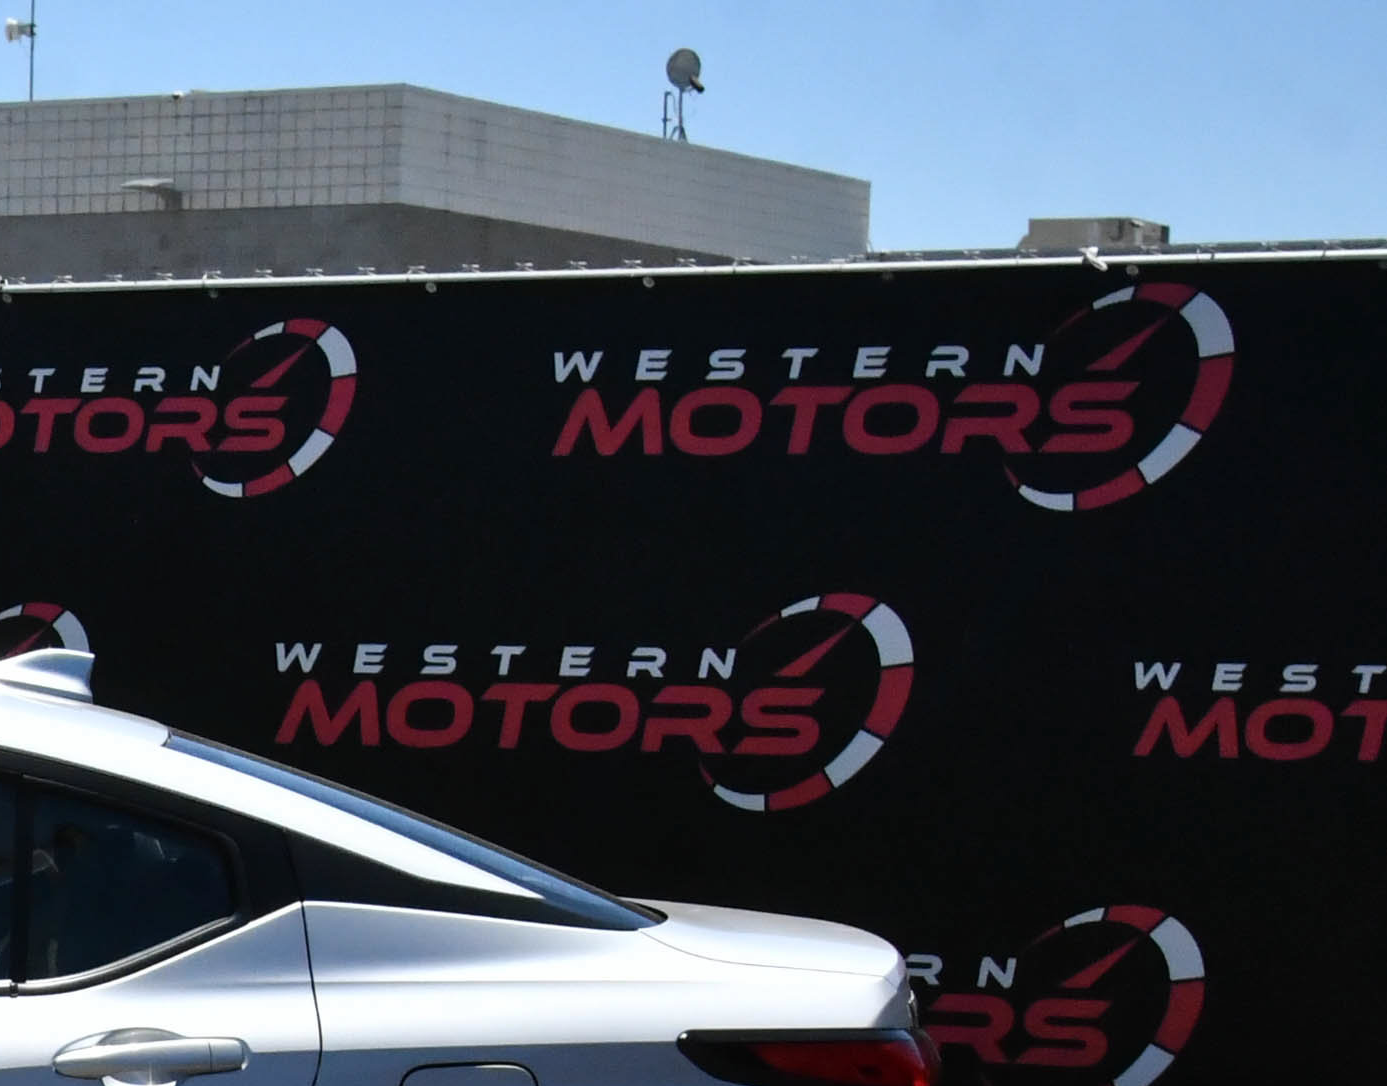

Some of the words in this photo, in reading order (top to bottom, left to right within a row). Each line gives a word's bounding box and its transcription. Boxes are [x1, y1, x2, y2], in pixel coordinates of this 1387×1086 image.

[553, 344, 1045, 383] WESTERN
[551, 382, 1140, 456] MOTORS
[274, 642, 737, 679] WESTERN
[1134, 661, 1387, 694] WEST
[274, 679, 826, 756] MOTORS
[1132, 695, 1387, 761] MOT
